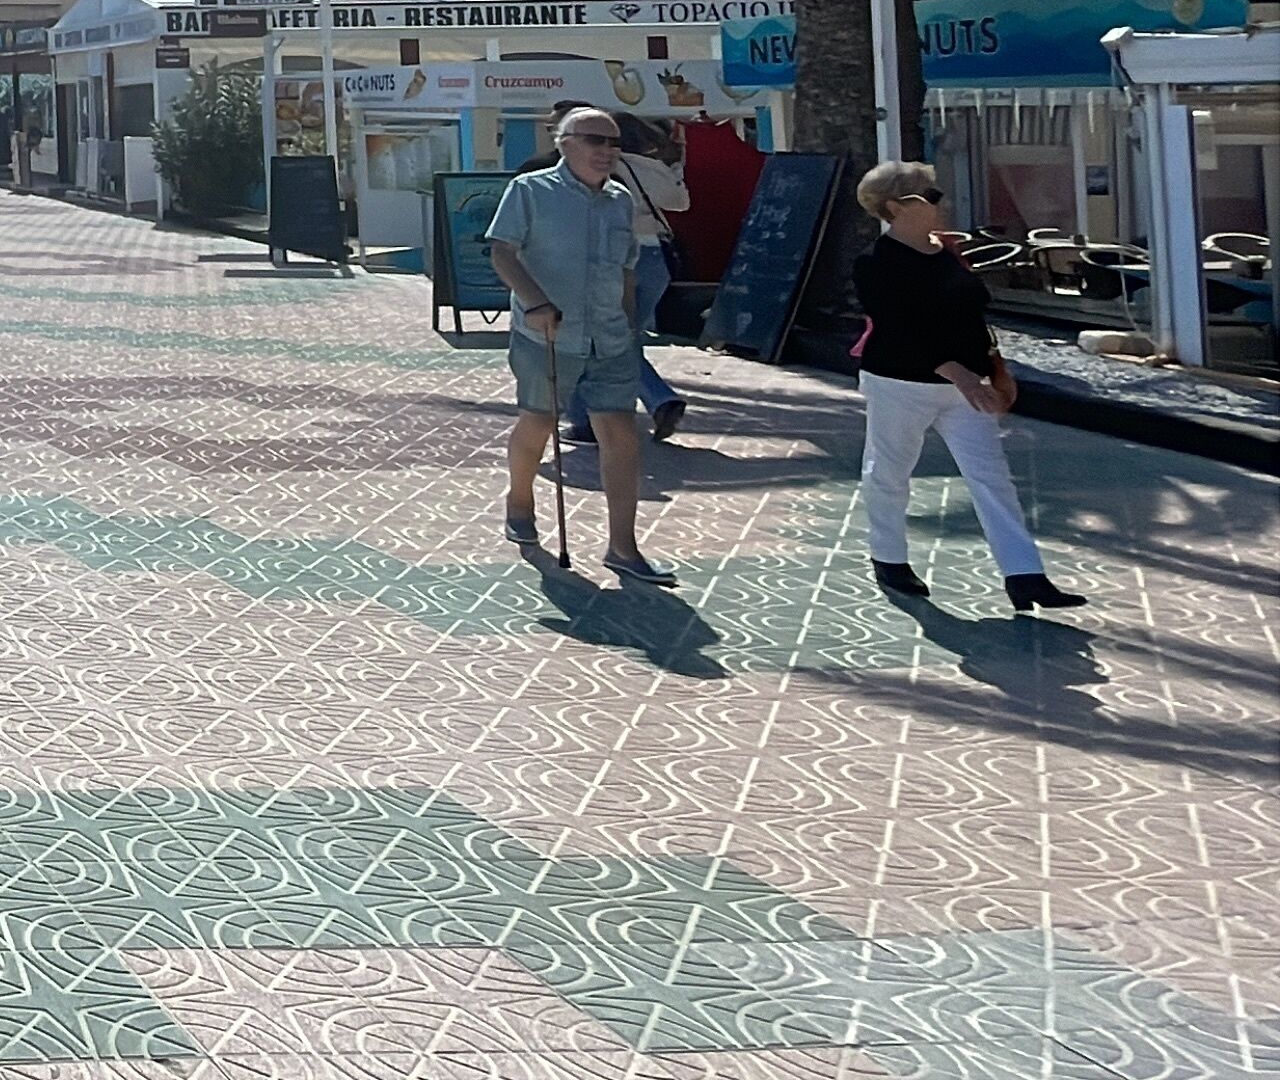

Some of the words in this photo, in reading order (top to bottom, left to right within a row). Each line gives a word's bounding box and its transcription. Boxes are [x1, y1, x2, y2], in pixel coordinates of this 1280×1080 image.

[404, 5, 587, 26] RESTAURANTE
[652, 1, 770, 23] TOPACIO
[485, 75, 564, 88] Cruzcampo
